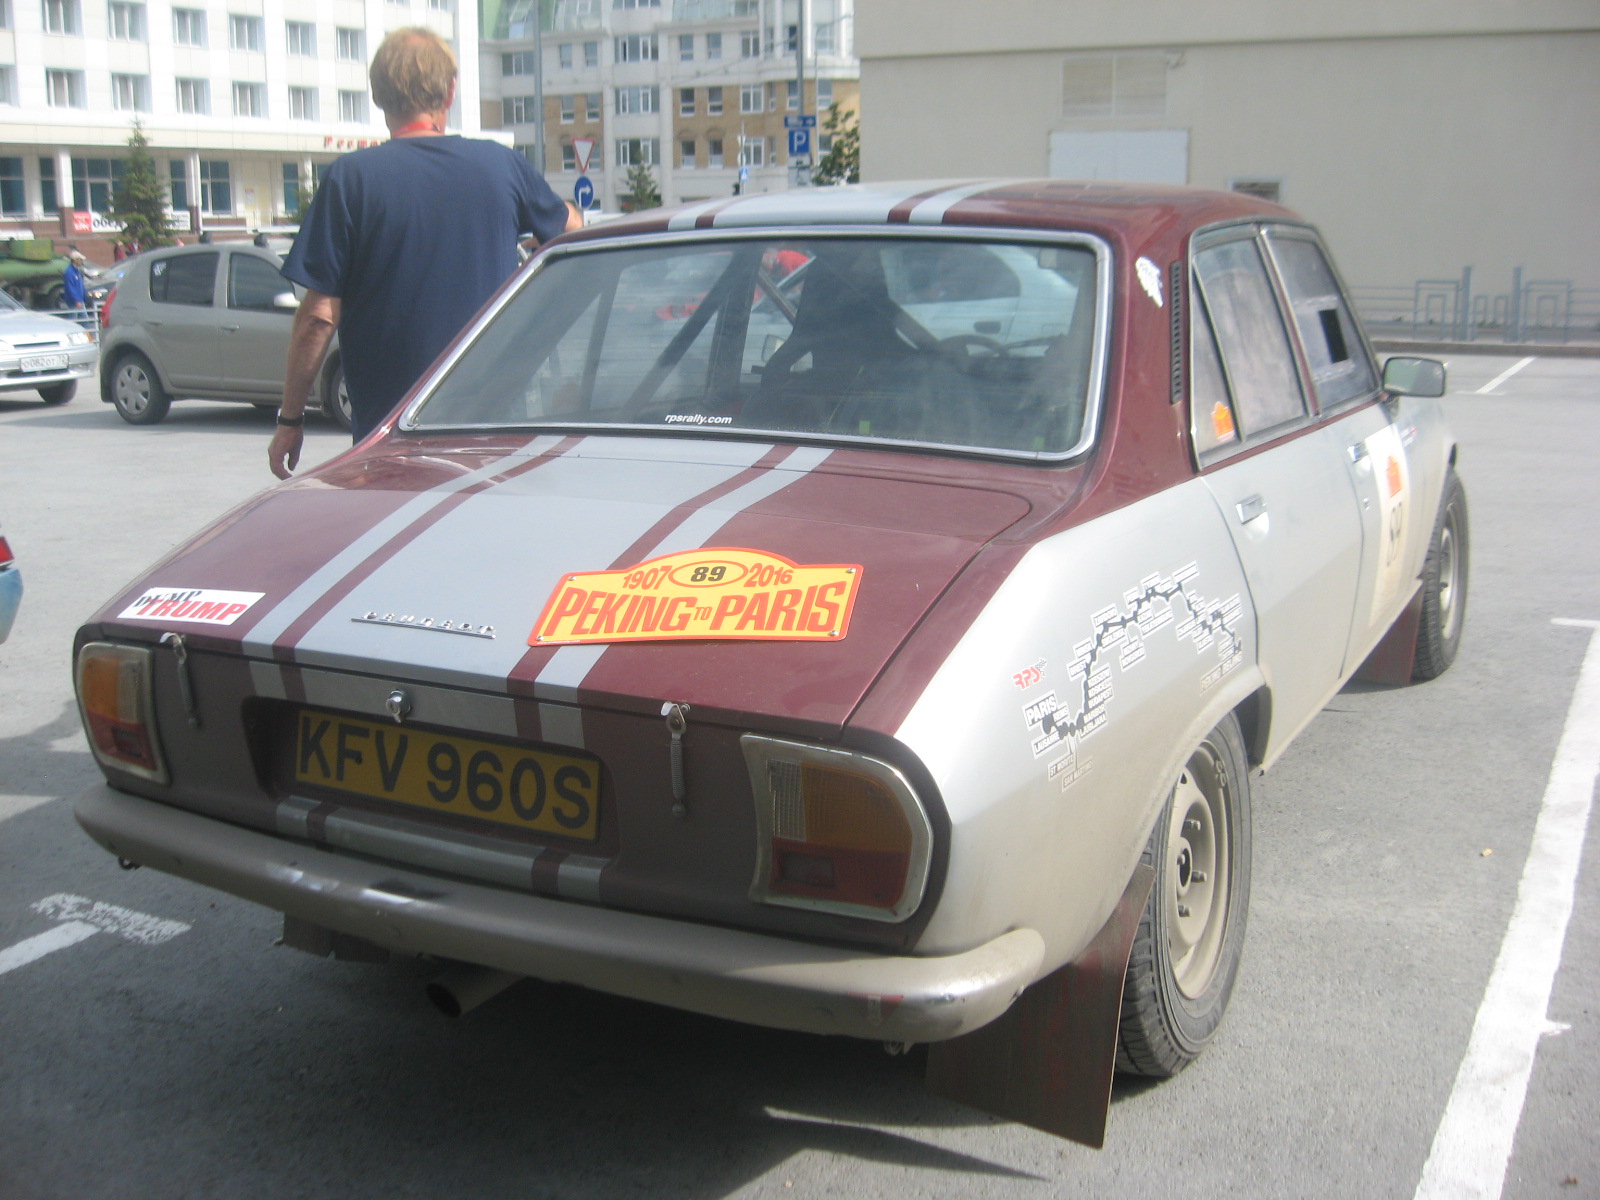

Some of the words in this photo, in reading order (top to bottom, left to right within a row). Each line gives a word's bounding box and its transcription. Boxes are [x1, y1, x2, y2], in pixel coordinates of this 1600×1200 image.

[793, 131, 807, 153] P
[664, 414, 733, 425] rpsrally.com
[622, 565, 673, 590] 1907
[690, 566, 727, 582] 89
[743, 563, 794, 588] 2016
[136, 599, 248, 621] TRUMP
[543, 587, 698, 637] PEKING
[693, 606, 711, 621] TO
[708, 581, 848, 633] PARIS
[1026, 695, 1057, 724] PARIS
[300, 716, 409, 793] KFV
[426, 742, 593, 820] 960S
